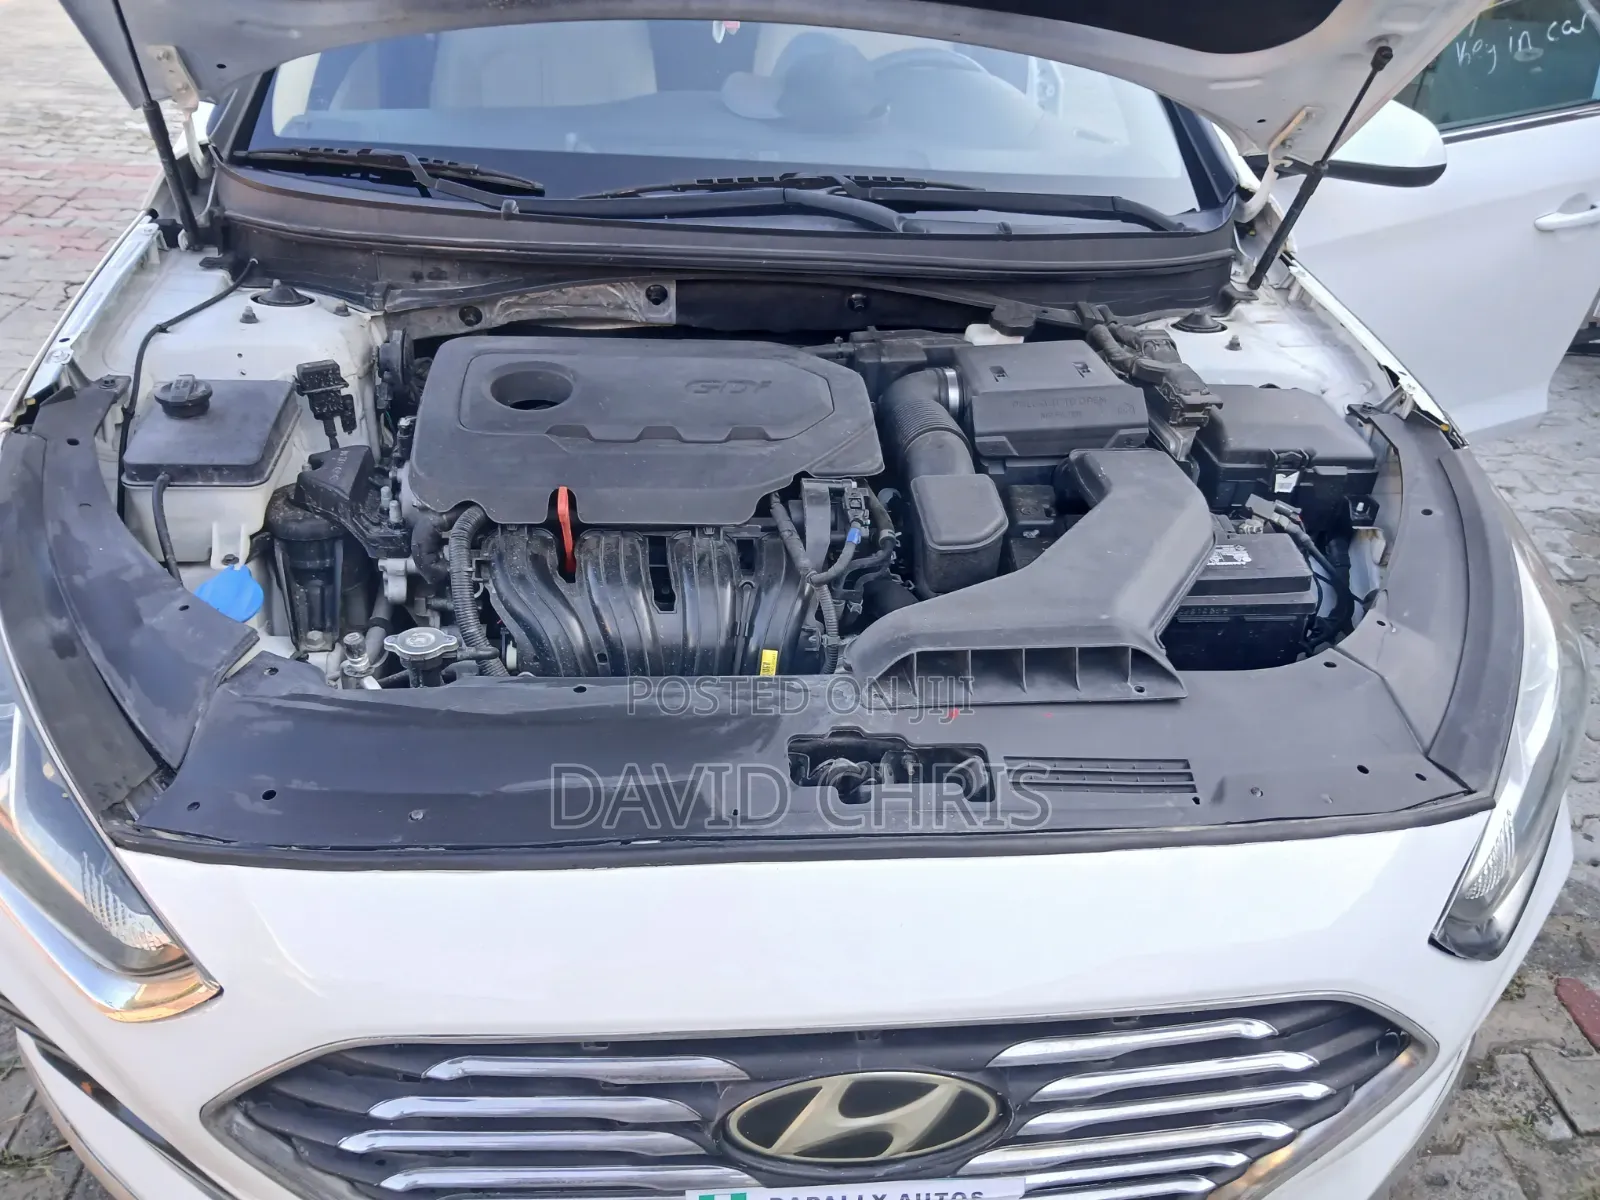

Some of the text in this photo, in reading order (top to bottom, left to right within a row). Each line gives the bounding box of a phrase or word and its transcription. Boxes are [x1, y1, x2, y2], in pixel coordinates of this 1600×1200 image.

[1508, 26, 1534, 53] in
[1546, 10, 1591, 41] car
[1079, 396, 1107, 406] OPEN
